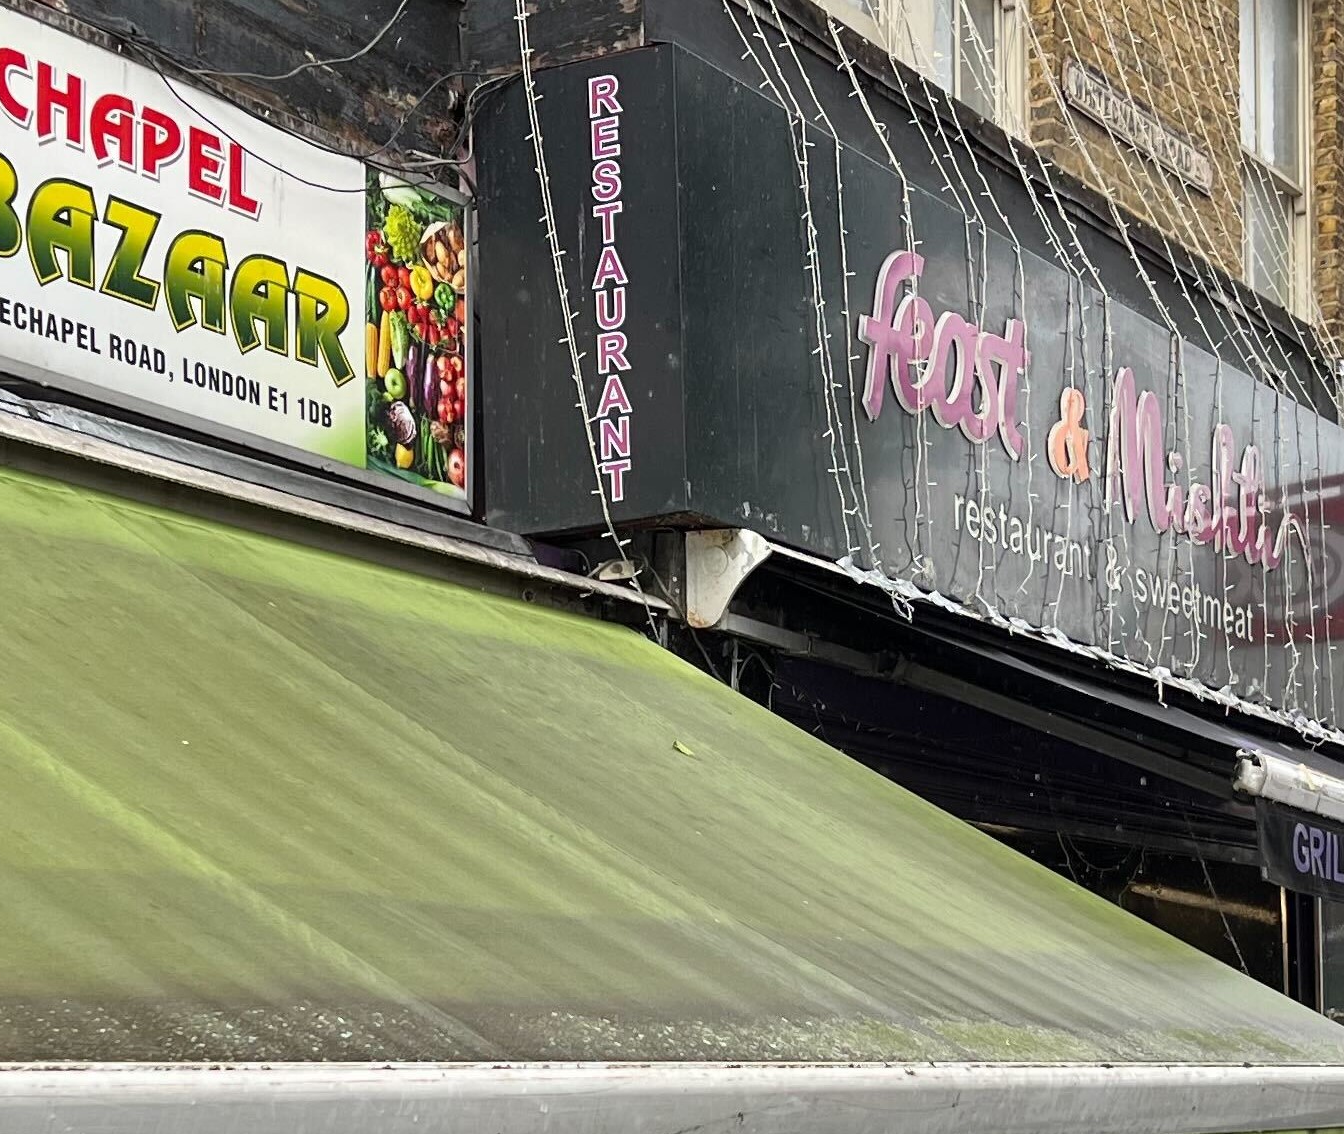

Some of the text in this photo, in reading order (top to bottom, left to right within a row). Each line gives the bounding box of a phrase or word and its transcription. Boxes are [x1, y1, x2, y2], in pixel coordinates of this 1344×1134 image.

[587, 73, 634, 501] RESTAURANT
[108, 333, 173, 382] ROAD,
[183, 357, 261, 406] LONDON
[268, 383, 289, 415] E1
[297, 397, 333, 428] 1DB
[1048, 387, 1090, 484] &
[954, 494, 1091, 580] restaurant
[1135, 567, 1253, 642] sweetmeat
